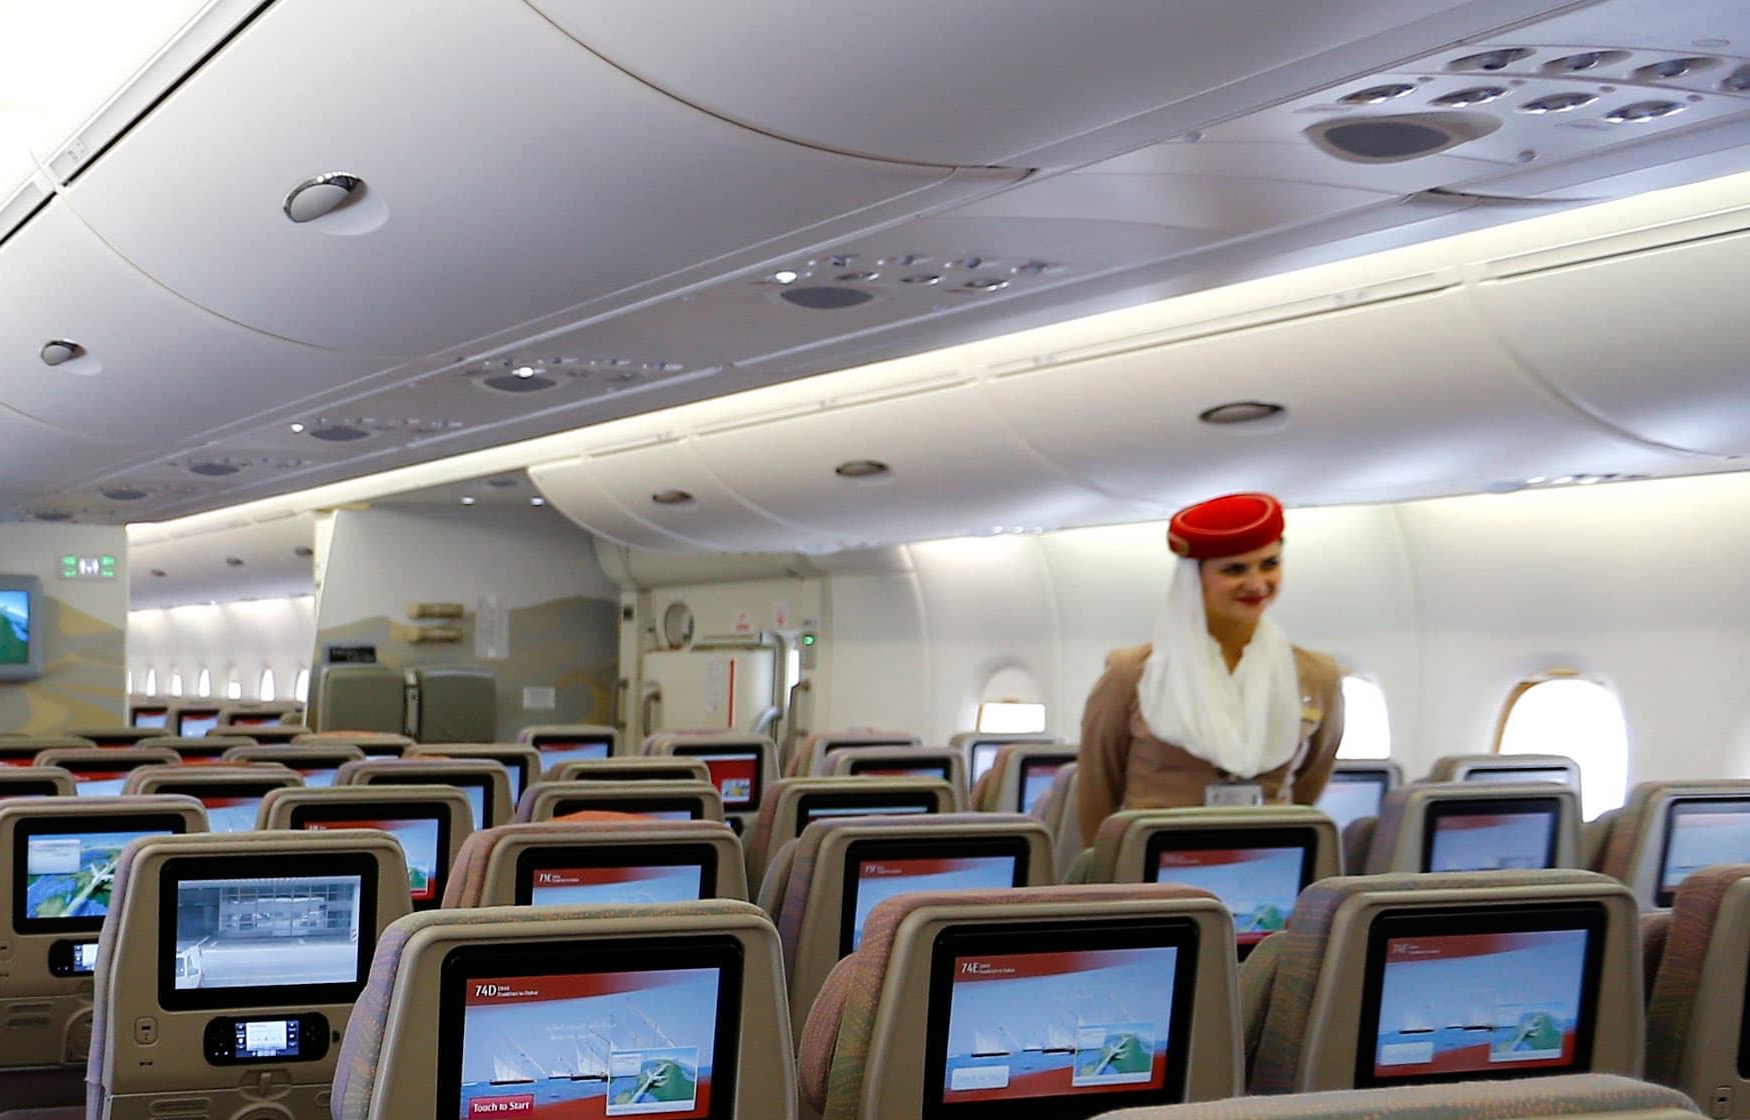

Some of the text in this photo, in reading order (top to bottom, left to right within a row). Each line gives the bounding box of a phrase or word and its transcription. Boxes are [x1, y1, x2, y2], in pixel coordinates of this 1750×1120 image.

[961, 963, 979, 974] 74E
[475, 985, 497, 997] 74D
[474, 1101, 530, 1113] Touch to Start
